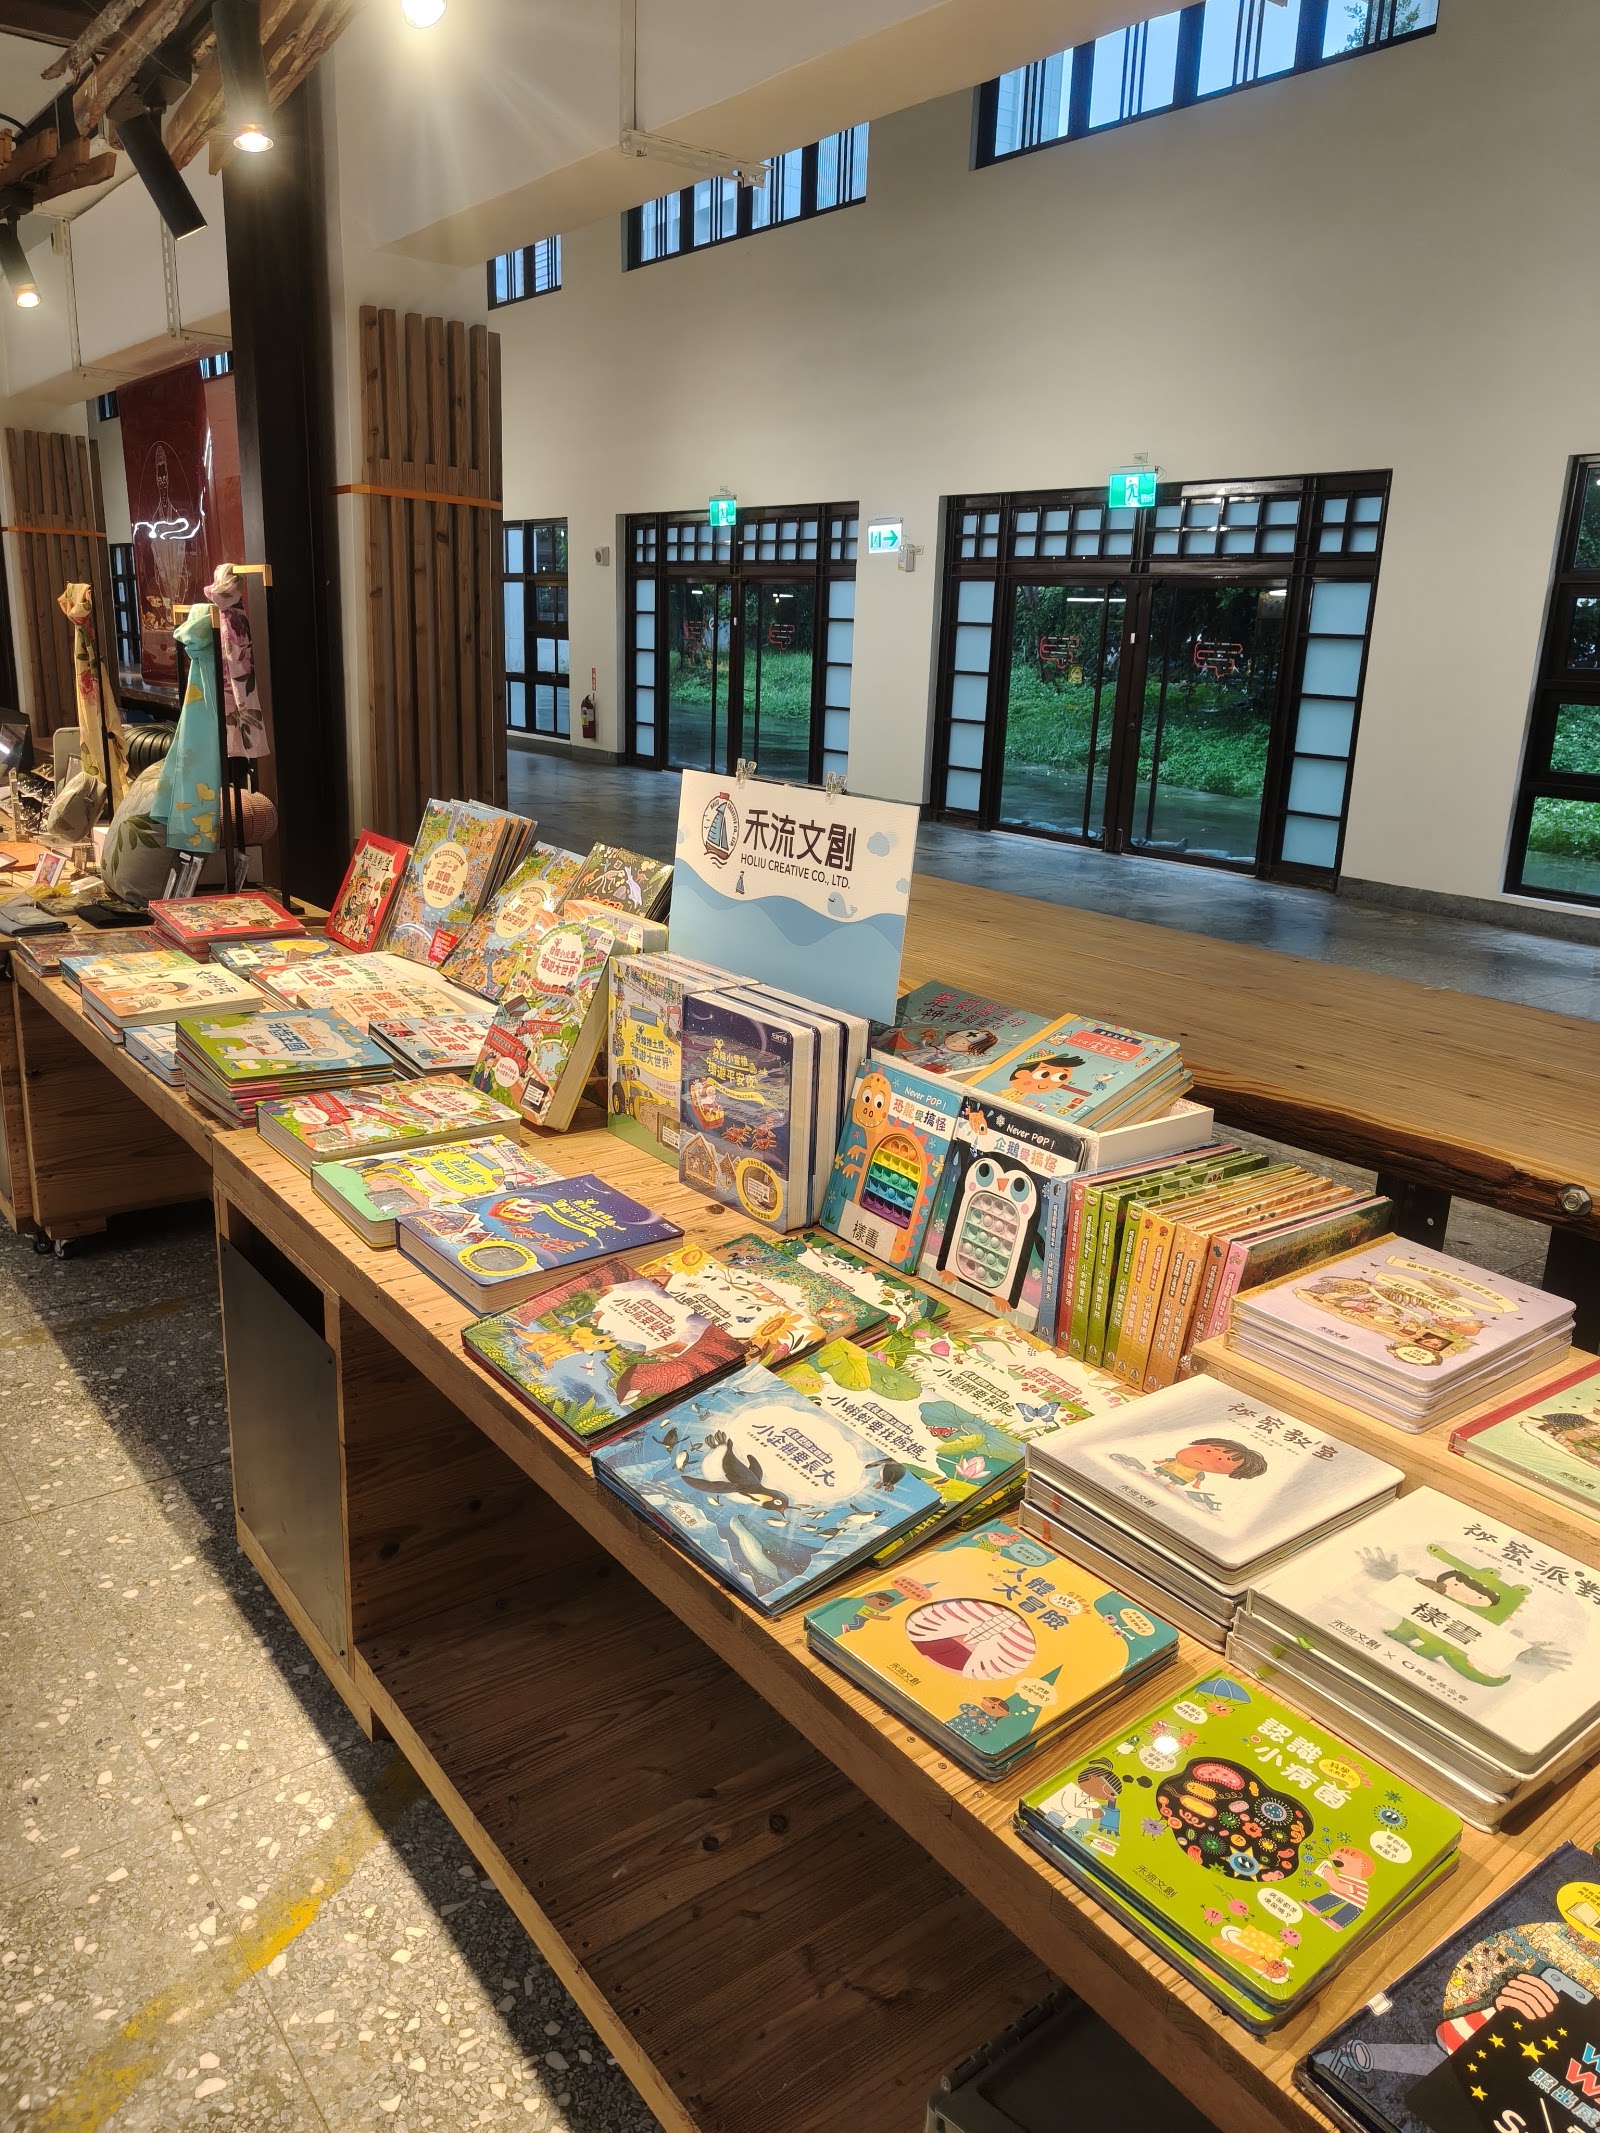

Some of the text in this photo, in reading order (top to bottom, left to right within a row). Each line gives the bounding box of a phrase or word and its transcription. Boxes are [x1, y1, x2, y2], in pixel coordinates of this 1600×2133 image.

[743, 808, 857, 872] 禾流文創
[740, 853, 851, 889] HOLIU CREATIVE CO., LTD.
[707, 1063, 755, 1088] 環遊平安夜
[904, 1087, 924, 1102] Never
[893, 1097, 947, 1132] 恐龍愛搞怪
[1006, 1123, 1029, 1139] Never
[994, 1136, 1058, 1173] 企鵝愛搞怪
[851, 1219, 880, 1250] 樣書
[612, 1298, 677, 1341] 小恐龍要變強
[933, 1368, 1016, 1417] 小刺蝟要探險
[1007, 1364, 1090, 1407] 小螞蟻要團結
[827, 1396, 927, 1463] 小蝌蚪要找媽媽
[1228, 1400, 1339, 1463] 祕密教室
[752, 1424, 836, 1488] 小企鵝要長大
[1003, 1567, 1056, 1601] 人體
[1058, 1596, 1076, 1605] 科學
[993, 1582, 1070, 1631] 大冒險
[1067, 1591, 1092, 1615] STEAM
[1330, 1617, 1382, 1650] 禾流文創
[1409, 1600, 1485, 1647] 樣書
[889, 1662, 921, 1686] 禾流文創
[1256, 1716, 1323, 1766] 認識
[1254, 1744, 1352, 1809] 小病菌
[1328, 1759, 1351, 1775] 科學
[1337, 1755, 1374, 1789] STEAM
[1134, 1864, 1176, 1899] 禾流文創
[1528, 2067, 1600, 2132] 照出威
